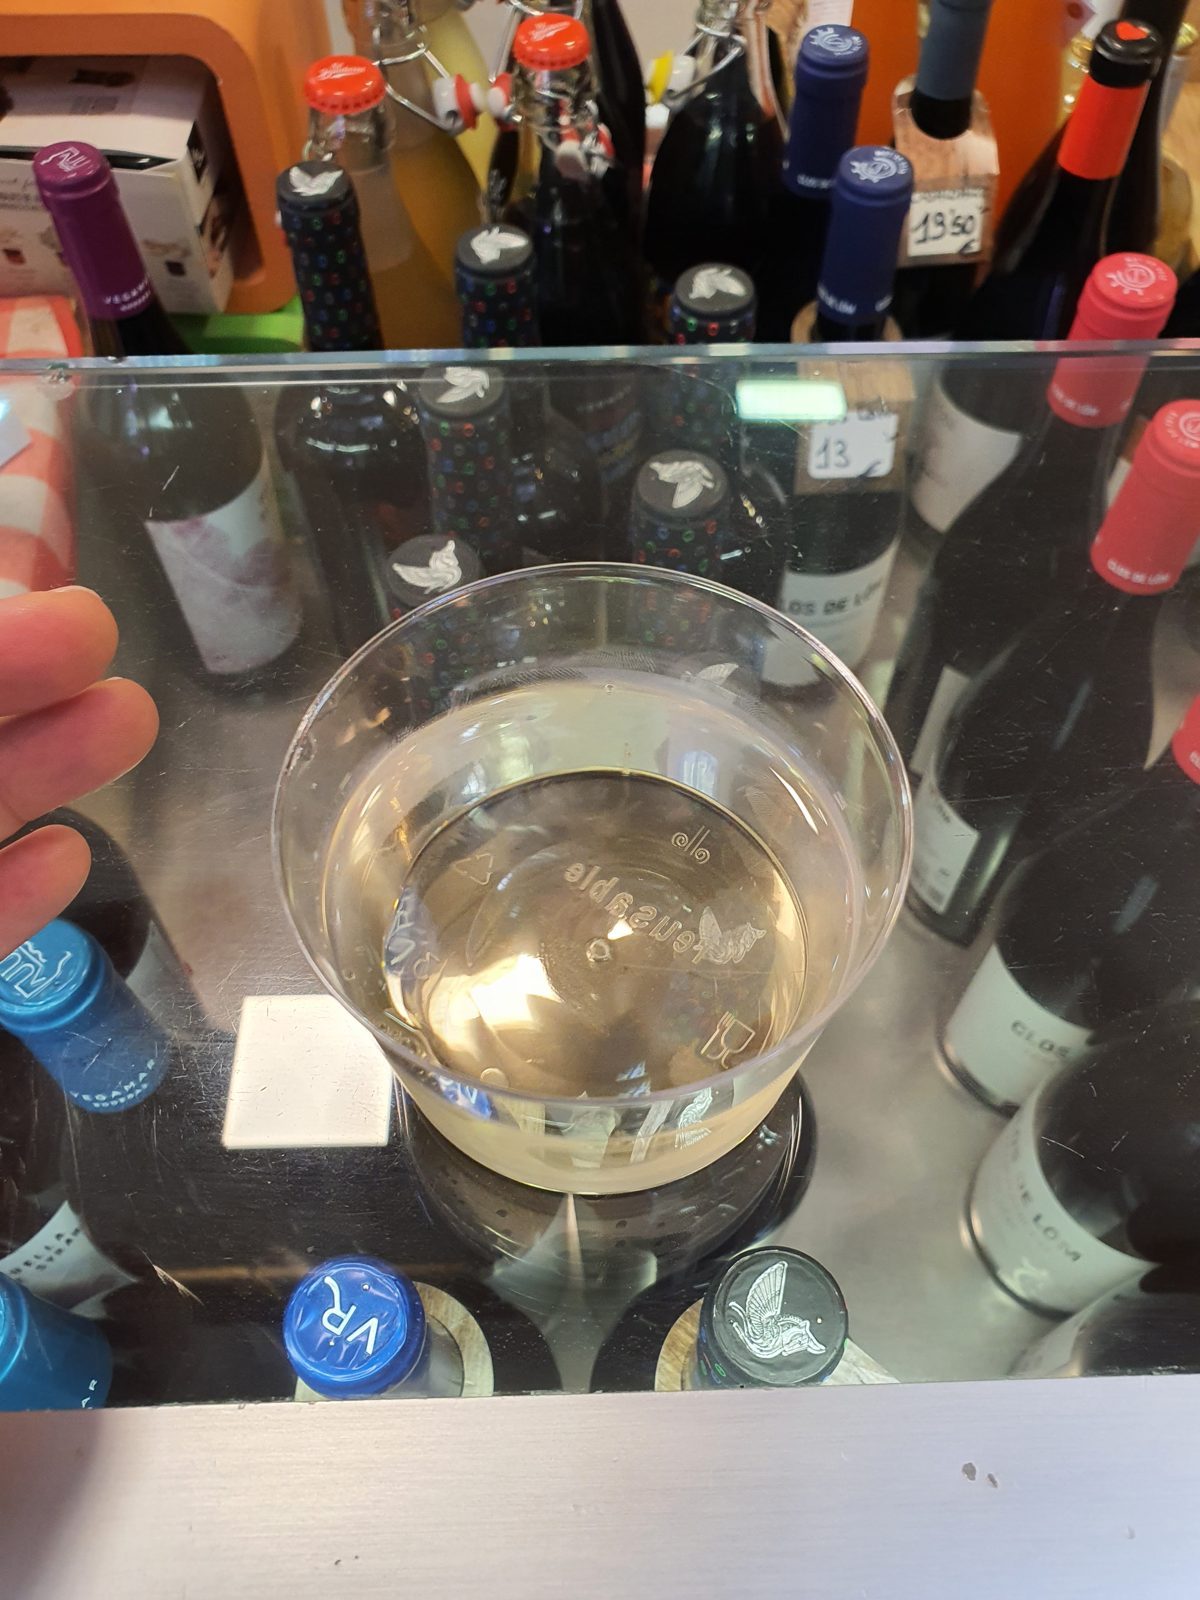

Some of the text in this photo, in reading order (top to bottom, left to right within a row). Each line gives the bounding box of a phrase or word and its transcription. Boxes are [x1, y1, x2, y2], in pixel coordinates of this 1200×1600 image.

[815, 437, 850, 469] 13
[823, 597, 848, 616] DE
[1010, 1019, 1072, 1058] CLOS
[70, 1058, 156, 1101] VEGAMAR
